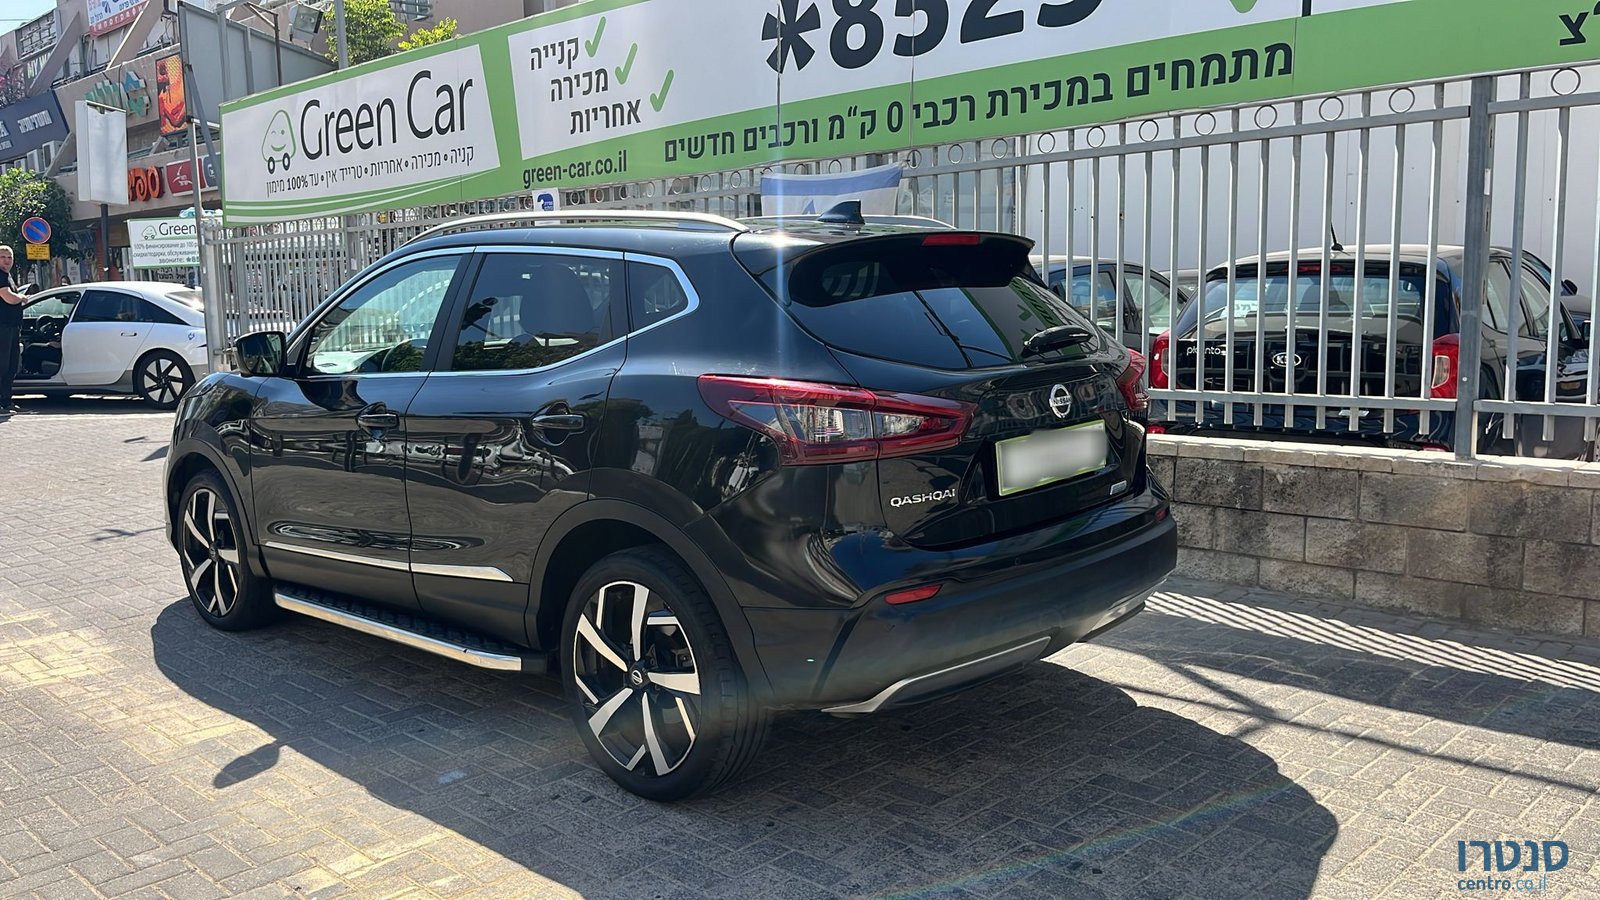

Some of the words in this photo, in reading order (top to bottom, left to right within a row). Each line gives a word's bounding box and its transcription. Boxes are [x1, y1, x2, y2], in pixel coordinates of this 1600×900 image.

[530, 37, 579, 70] קנייה
[1126, 42, 1293, 98] מתמחים
[550, 68, 609, 102] מכירה
[986, 72, 1113, 119] במכירת
[300, 98, 397, 160] Green
[407, 70, 473, 139] Car
[570, 99, 641, 135] אחריות
[886, 101, 903, 133] 0
[912, 94, 976, 129] רכבי
[664, 131, 735, 162] חדשים
[743, 118, 818, 151] ורכבים
[370, 158, 403, 176] אחריות
[411, 151, 441, 170] מכירה
[450, 146, 474, 166] קניה
[310, 173, 319, 187] עד
[325, 168, 337, 188] אין
[341, 165, 363, 181] טרייד
[522, 149, 627, 189] green-car.co.il
[266, 178, 285, 198] מימון
[287, 175, 309, 191] 100%
[159, 222, 197, 236] Green
[1186, 346, 1221, 356] pinto
[890, 488, 956, 508] QASHQAI
